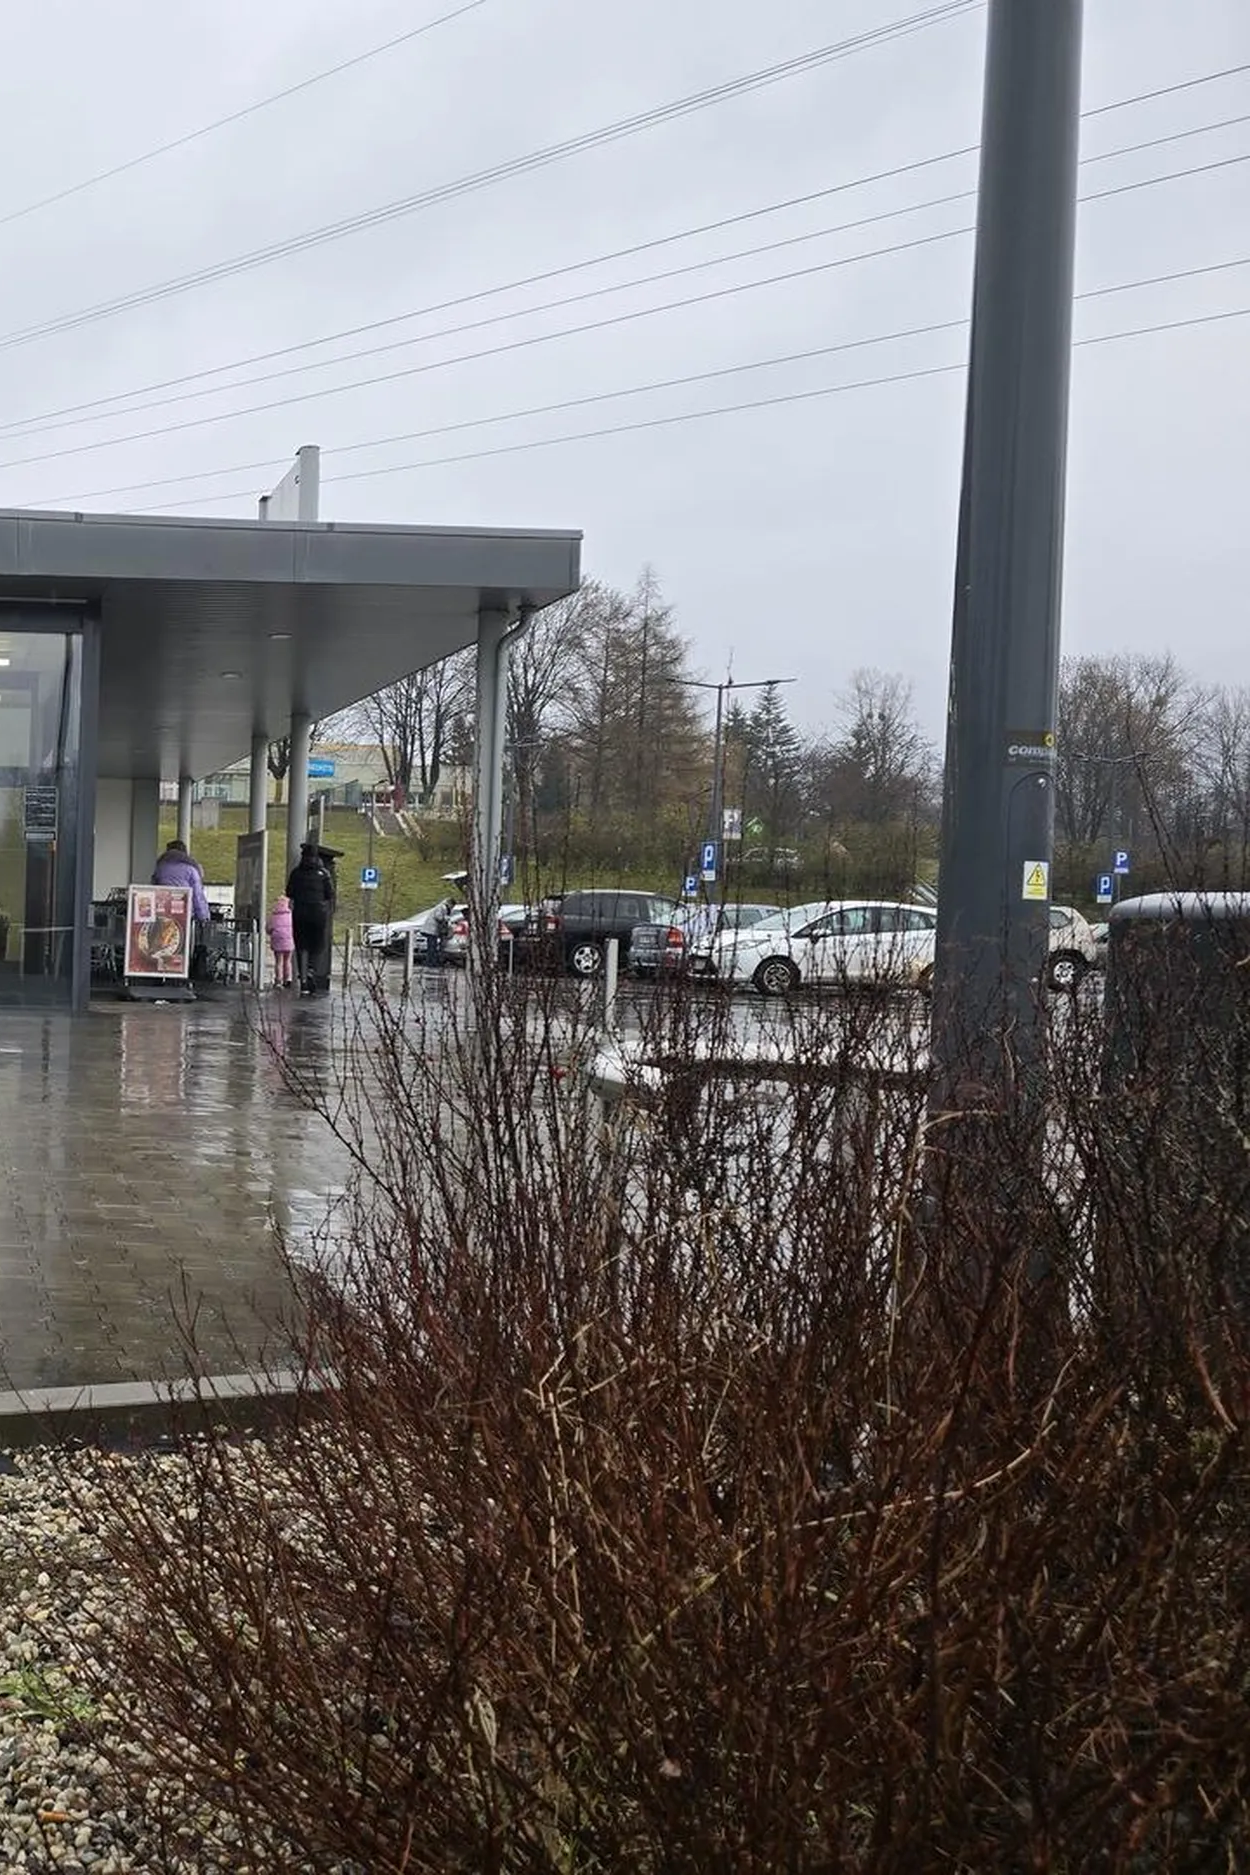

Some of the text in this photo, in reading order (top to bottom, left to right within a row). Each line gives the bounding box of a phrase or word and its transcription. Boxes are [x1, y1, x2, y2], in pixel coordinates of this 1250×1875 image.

[704, 845, 714, 868] P
[1116, 852, 1127, 866] P
[365, 869, 376, 881] P
[685, 876, 695, 889] P
[1100, 876, 1110, 893] P
